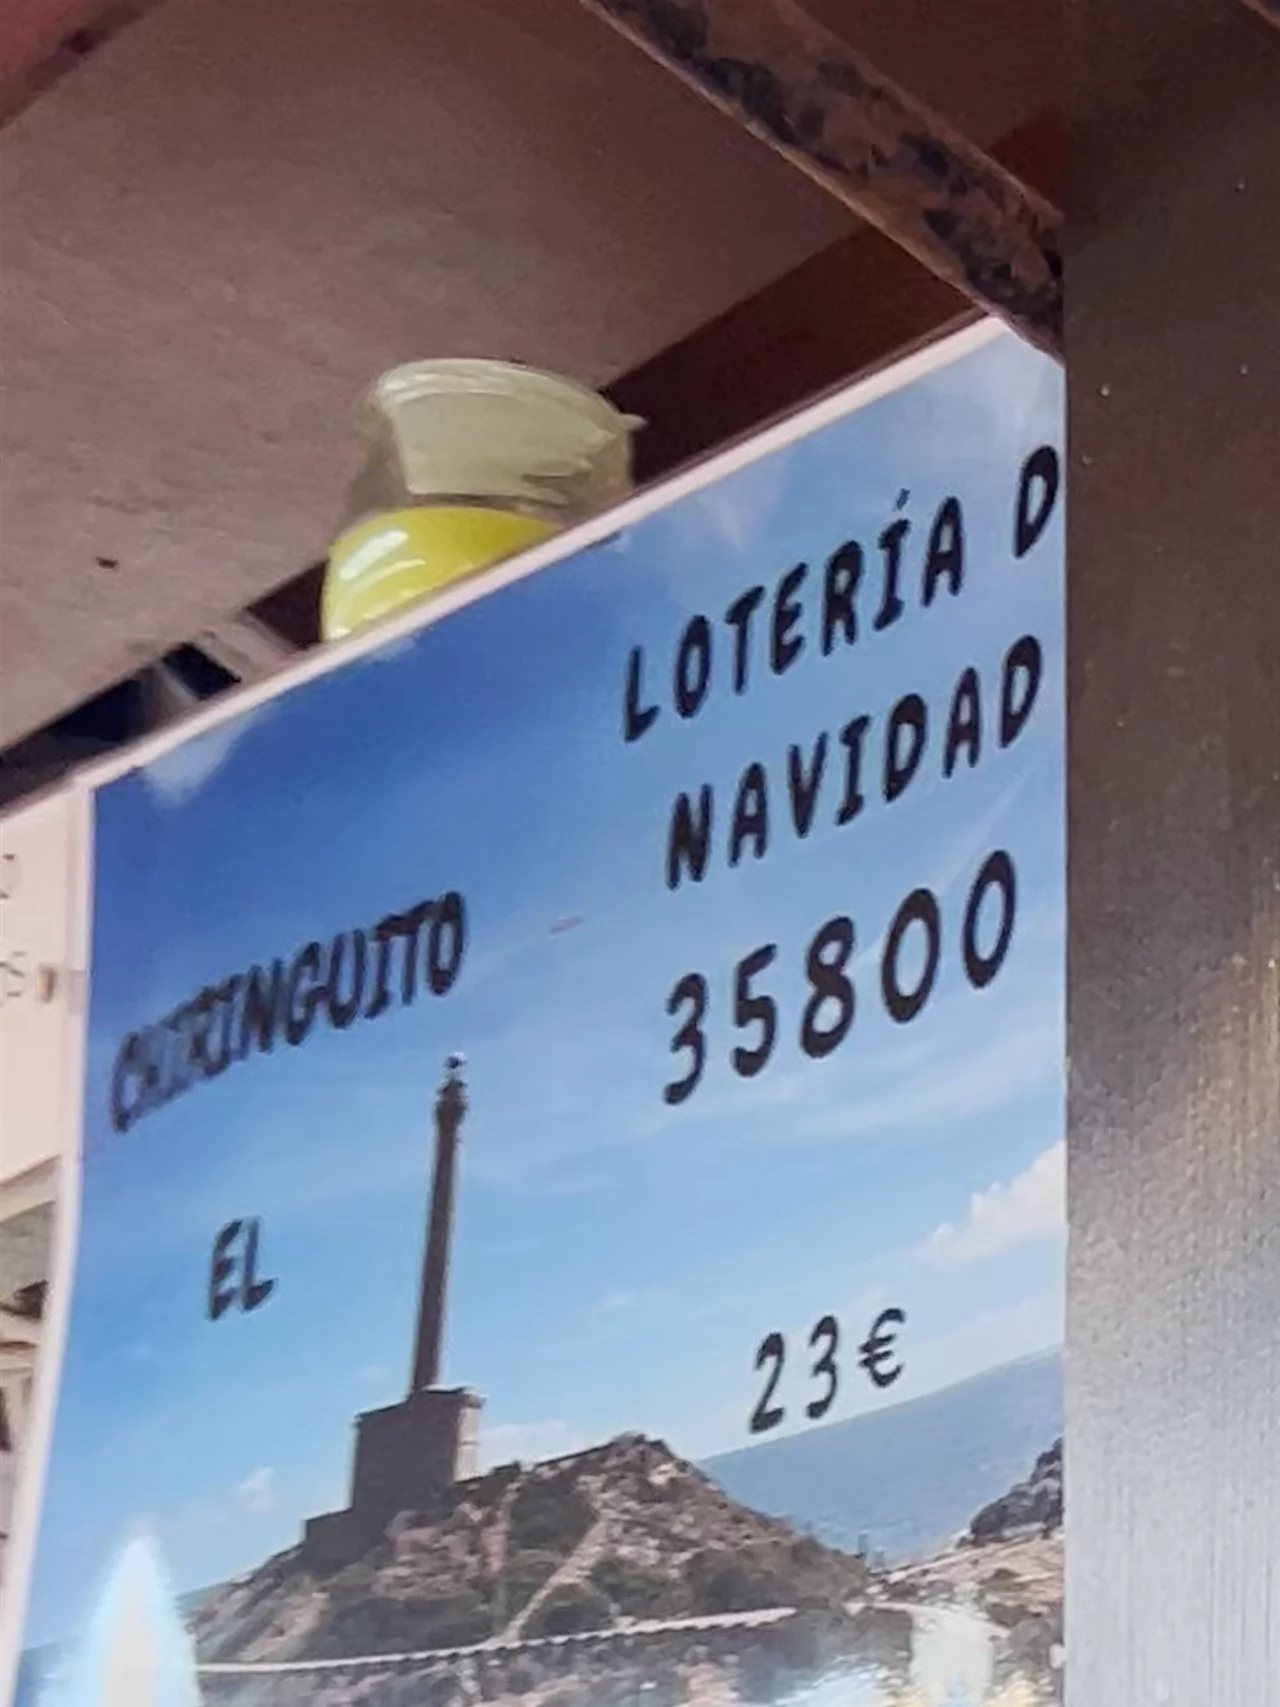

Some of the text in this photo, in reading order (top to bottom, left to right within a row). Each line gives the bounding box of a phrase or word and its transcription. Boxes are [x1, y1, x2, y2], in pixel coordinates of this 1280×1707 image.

[622, 488, 966, 743] LOTERÍA
[665, 633, 1042, 890] NAVIDAD
[662, 848, 1017, 1105] 35800
[209, 1215, 279, 1321] EL
[749, 1307, 906, 1435] 23€
